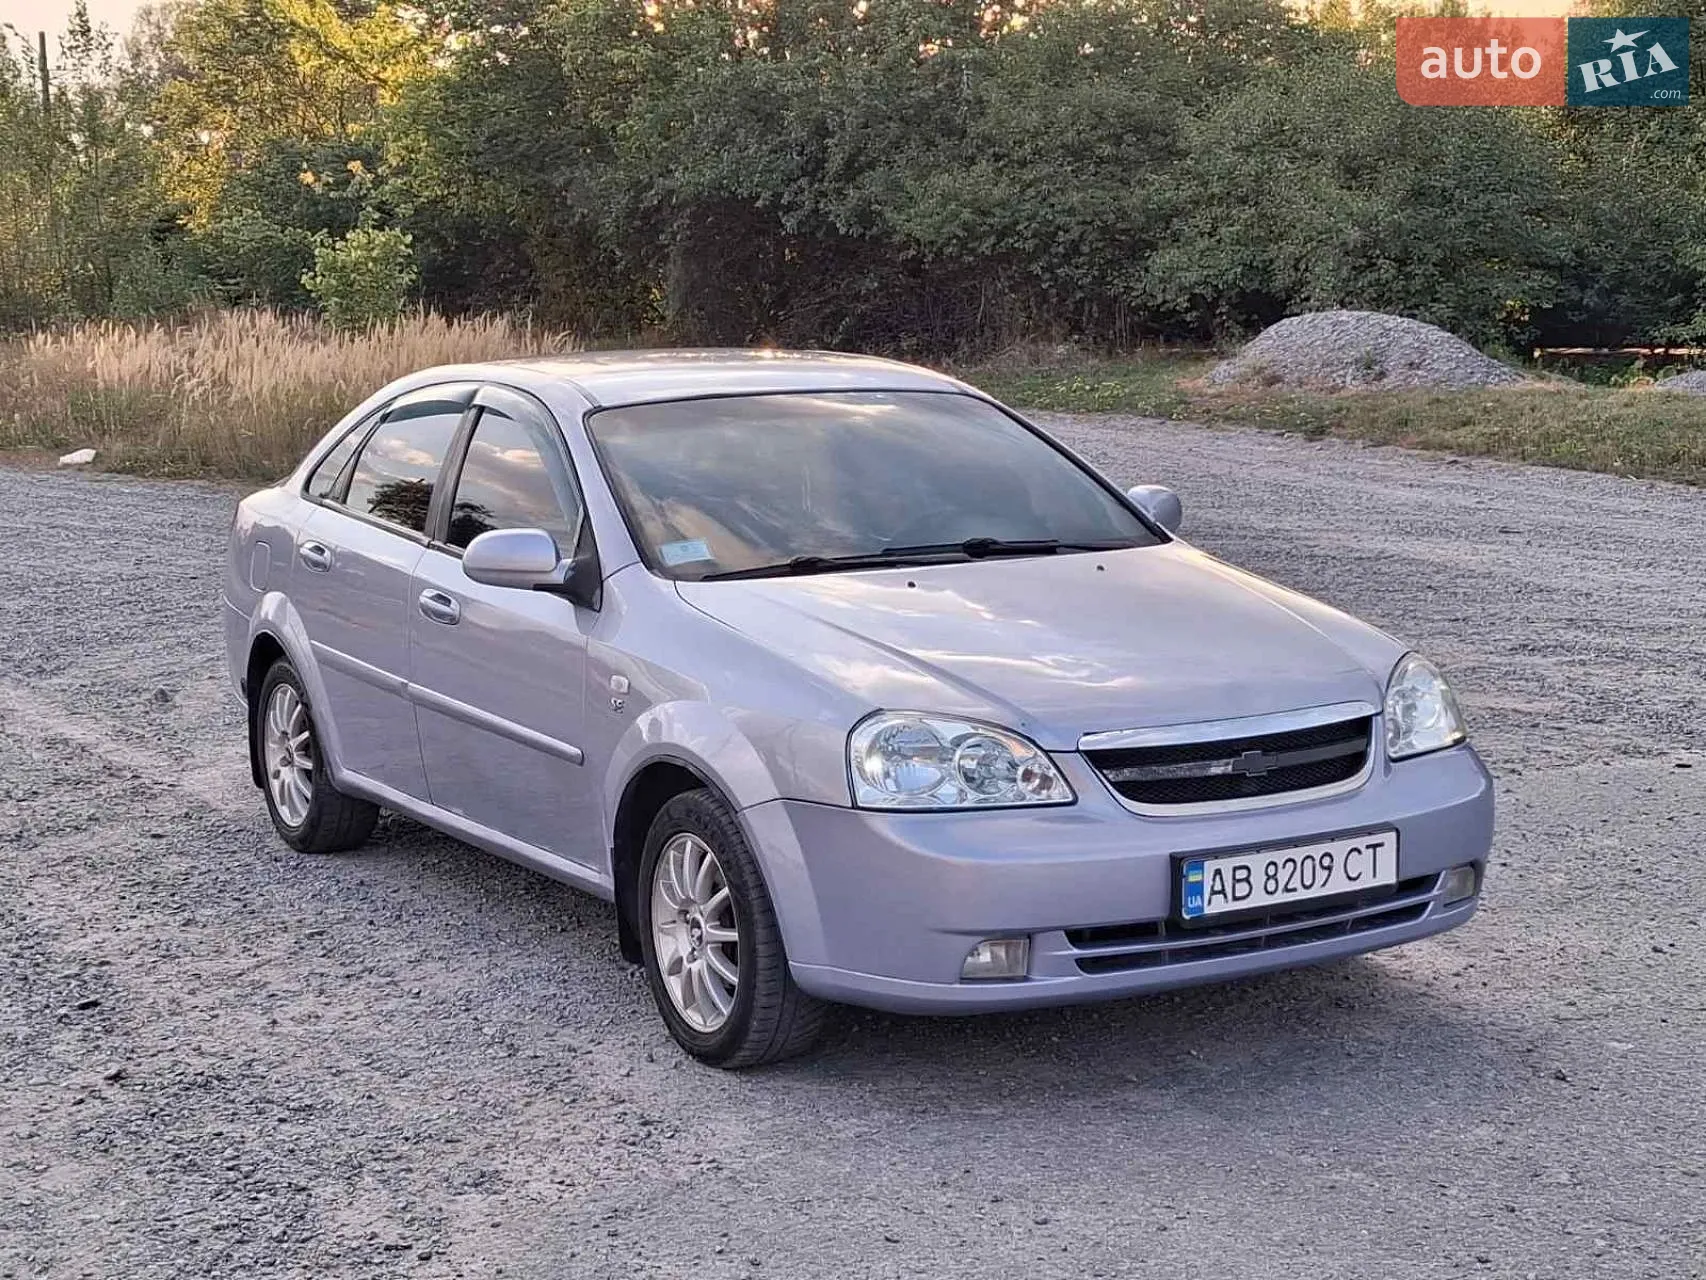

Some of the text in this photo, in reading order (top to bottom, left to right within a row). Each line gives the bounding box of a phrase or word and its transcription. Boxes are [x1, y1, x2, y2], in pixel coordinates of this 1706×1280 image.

[1207, 841, 1385, 906] AB 8209 CT
